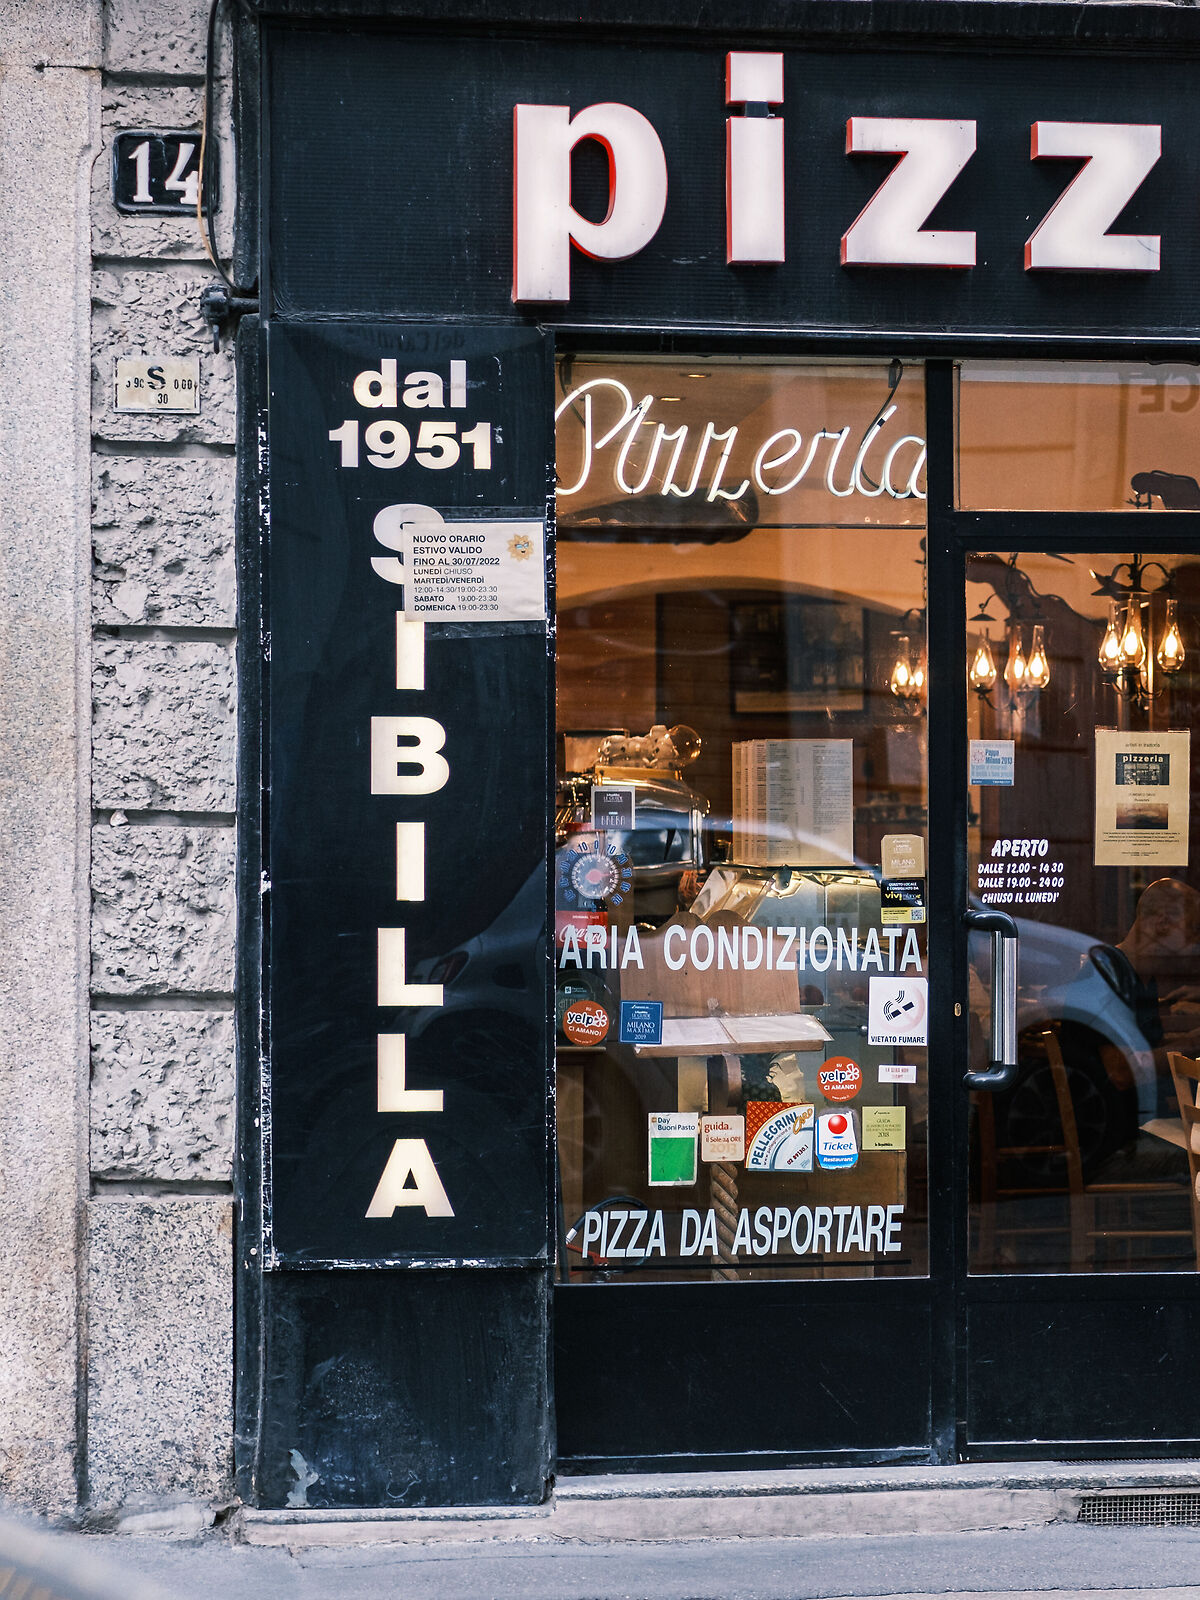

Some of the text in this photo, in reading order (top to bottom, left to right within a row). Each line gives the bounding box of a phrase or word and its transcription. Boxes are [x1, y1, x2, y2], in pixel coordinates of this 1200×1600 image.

[128, 141, 203, 205] 14
[353, 358, 467, 409] dal
[157, 393, 168, 404] 30
[328, 419, 492, 470] 1951
[555, 378, 927, 502] Pizzeria
[413, 535, 486, 543] NUOVO ORARIO
[413, 546, 482, 554] ESTIVO VALIDO
[452, 557, 500, 566] 30/07/2022
[413, 567, 442, 575] LUNEDÌ
[1122, 754, 1164, 763] pizzeria
[991, 838, 1049, 858] APERTO
[364, 503, 457, 1219] SIBILLA
[977, 863, 1005, 874] DALLE
[1006, 862, 1030, 874] 12.00
[977, 877, 1005, 888] DALLE
[1006, 877, 1031, 888] 19.00
[981, 892, 1013, 904] CHIUSO
[1014, 892, 1024, 903] IL
[559, 924, 923, 972] ARIA CONDIZIONATA
[567, 1012, 595, 1028] yelp
[871, 1035, 897, 1043] VIETATO
[820, 1069, 848, 1084] yelp
[658, 1117, 670, 1125] Day
[752, 1112, 797, 1165] PELLEGRINI
[823, 1141, 854, 1151] Ticket
[581, 1205, 905, 1259] PIZZA DA ASPORTARE
